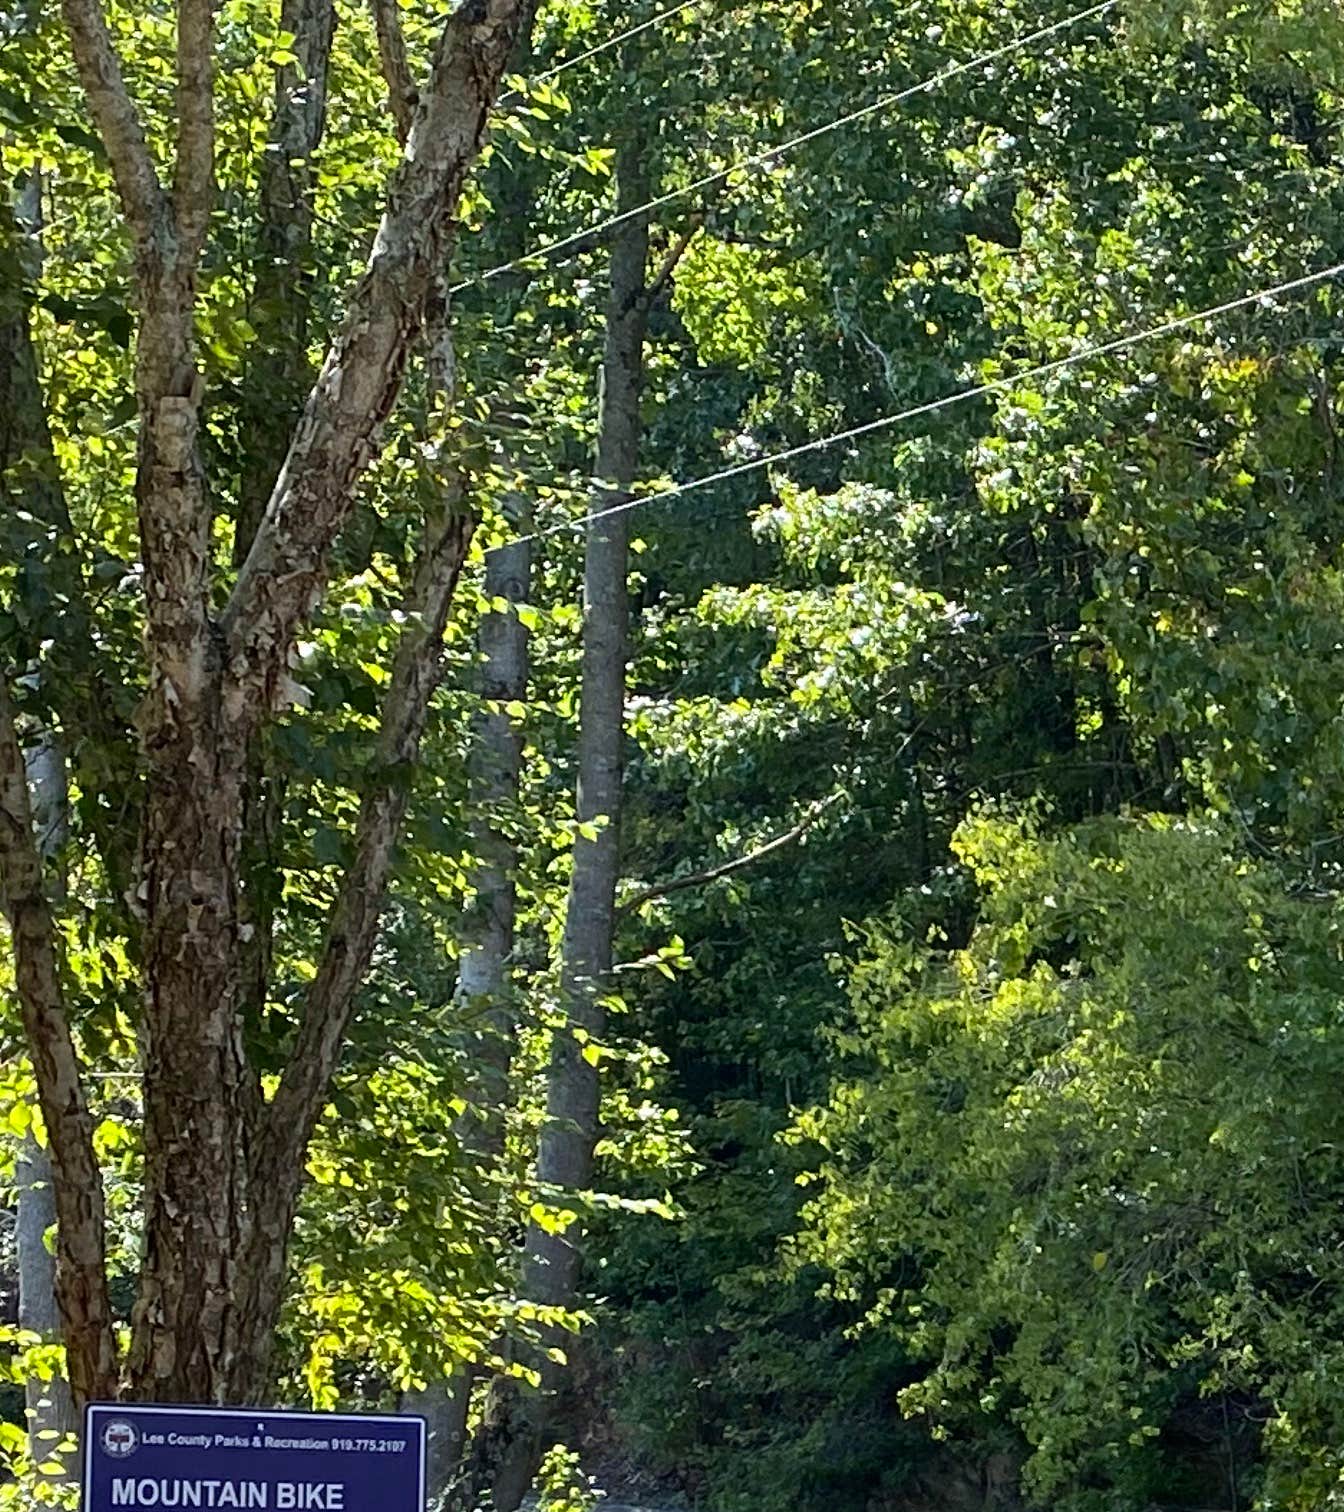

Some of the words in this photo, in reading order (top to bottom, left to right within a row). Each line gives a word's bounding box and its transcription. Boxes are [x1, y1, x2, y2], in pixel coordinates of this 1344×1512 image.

[142, 1432, 165, 1444] Lee
[167, 1432, 212, 1449] County
[215, 1434, 249, 1447] Parks
[252, 1435, 262, 1448] &
[264, 1435, 329, 1450] Recreation
[111, 1478, 268, 1508] MOUNTAIN
[276, 1482, 344, 1510] BIKE
